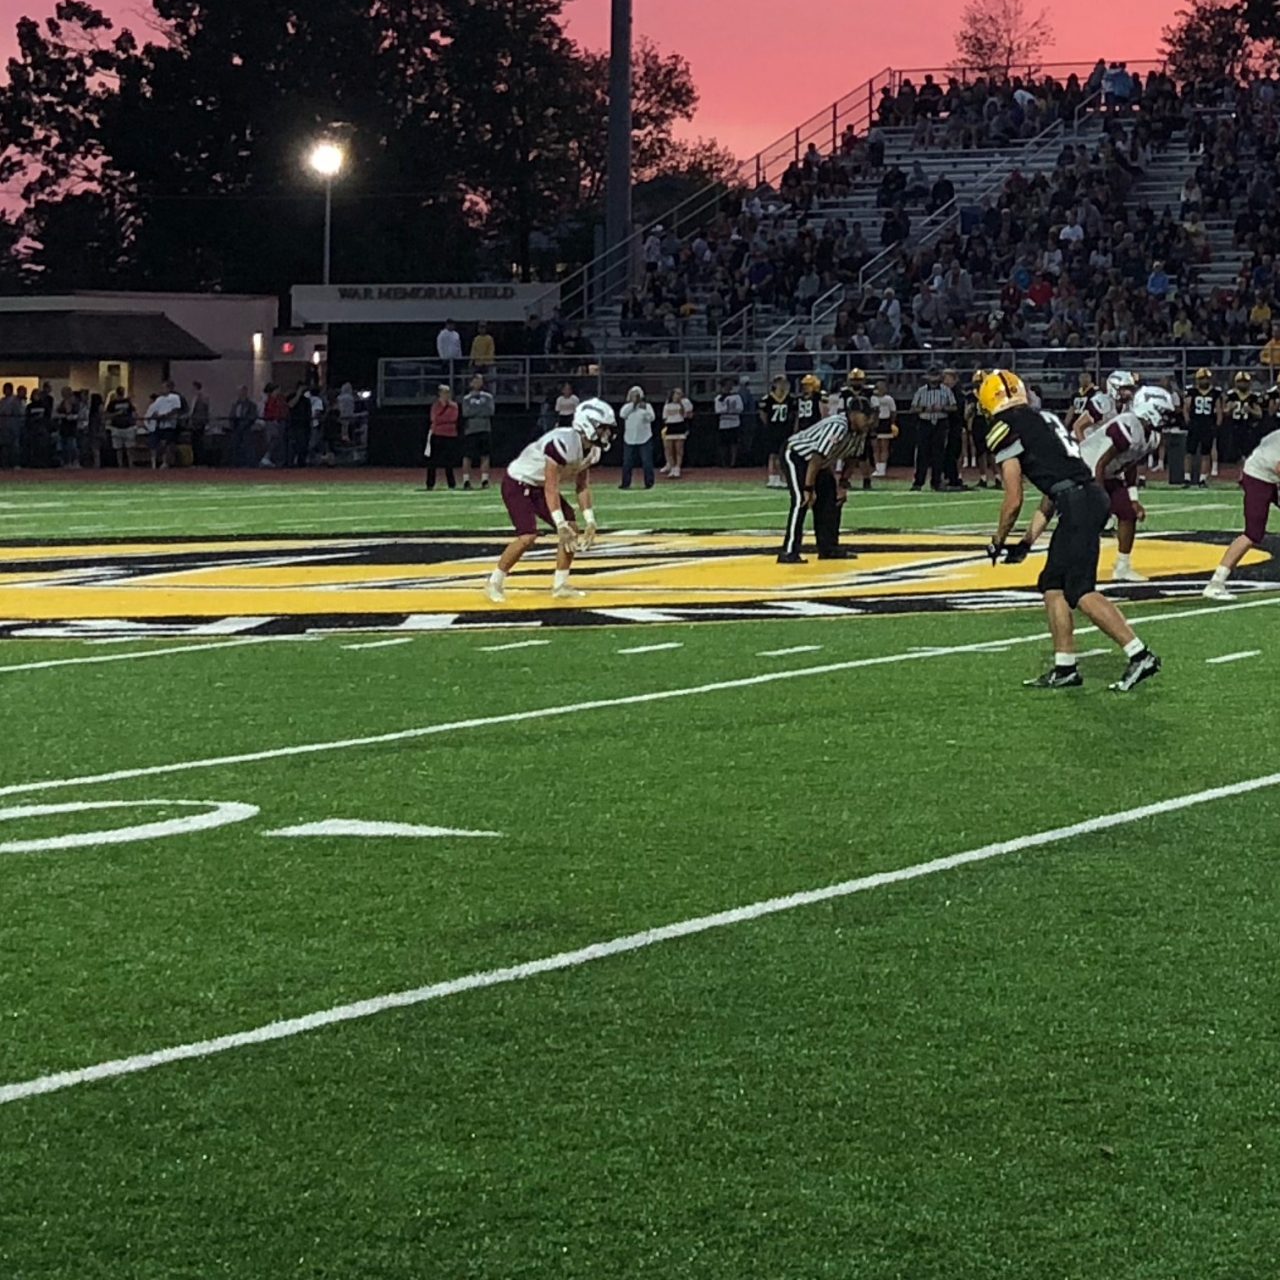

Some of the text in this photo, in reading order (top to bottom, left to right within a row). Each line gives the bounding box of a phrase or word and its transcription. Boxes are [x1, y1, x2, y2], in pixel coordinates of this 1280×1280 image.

[338, 286, 514, 300] WAR MEMORIAL FIELD
[770, 403, 788, 423] 70
[1194, 396, 1213, 415] 95
